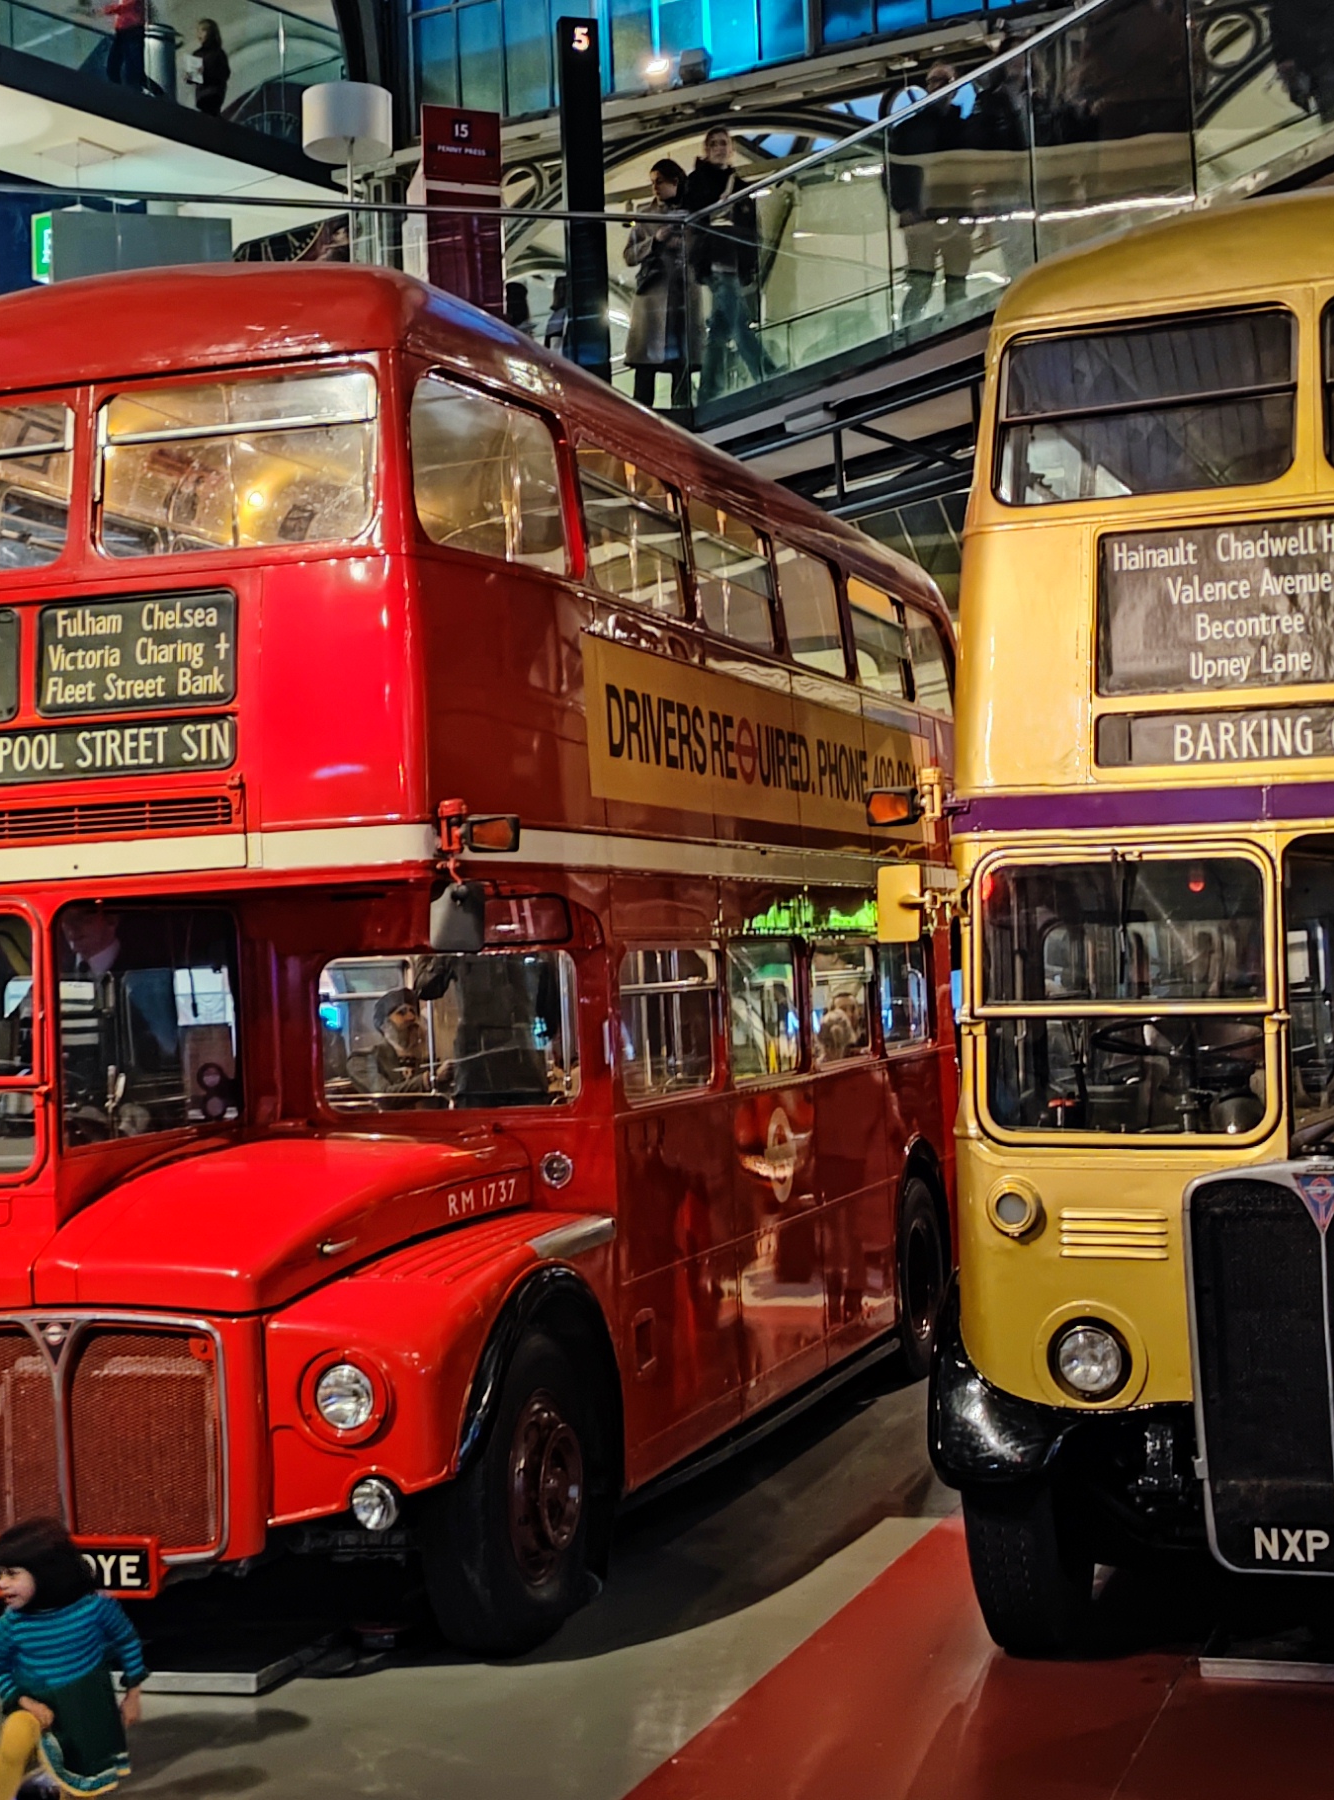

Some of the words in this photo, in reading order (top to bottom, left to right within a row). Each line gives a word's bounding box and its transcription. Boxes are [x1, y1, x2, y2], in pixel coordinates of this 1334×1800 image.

[572, 26, 590, 51] 5
[454, 124, 469, 138] 15
[437, 144, 462, 154] PENNY
[464, 146, 486, 157] PRESS
[1113, 537, 1197, 571] Hainault
[1217, 526, 1317, 562] Chadwell
[1167, 574, 1251, 605] Valence
[1260, 568, 1332, 597] Avenue
[56, 609, 122, 639] Fulham
[141, 602, 218, 631] Chelsea
[1195, 612, 1305, 642] Becontree
[48, 643, 121, 672] Victoria
[135, 637, 205, 669] Charing
[1189, 651, 1251, 685] Upney
[1260, 645, 1312, 674] Lane
[46, 677, 96, 705] Fleet
[103, 673, 166, 701] Street
[177, 666, 225, 696] Bank
[76, 726, 168, 767] STREET
[181, 722, 229, 761] STN
[605, 683, 707, 775] DRIVERS
[817, 738, 868, 803] PHONE
[1173, 715, 1314, 762] BARKING
[447, 1189, 475, 1217] RM
[482, 1178, 516, 1208] 1737
[1253, 1527, 1330, 1562] NXP
